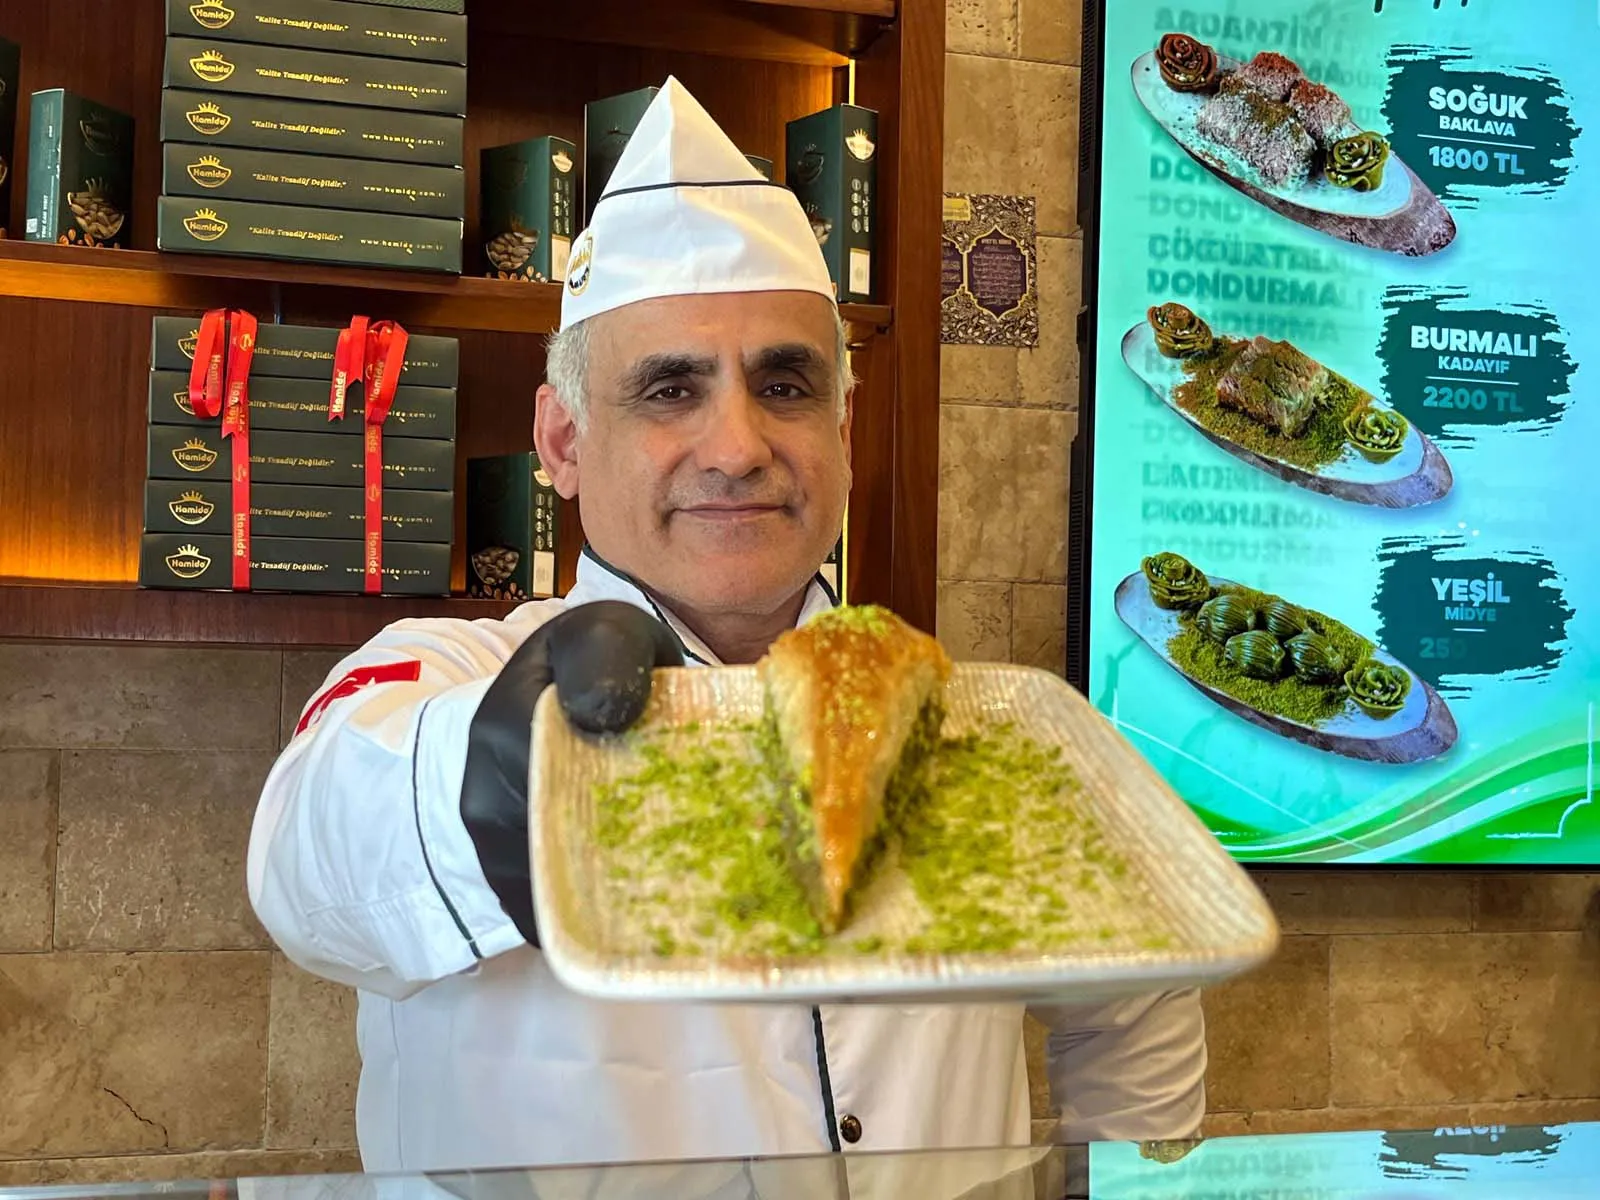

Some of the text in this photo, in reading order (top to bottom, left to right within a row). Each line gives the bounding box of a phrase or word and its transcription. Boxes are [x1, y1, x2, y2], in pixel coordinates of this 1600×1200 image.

[196, 9, 230, 19] Hamido
[196, 62, 230, 73] Hamido
[1428, 84, 1528, 120] SOĞUK
[192, 115, 226, 125] Hamido
[1439, 115, 1517, 138] BAKLAVA
[1428, 146, 1525, 175] 1800 TL
[193, 168, 227, 178] Hamido
[189, 221, 223, 232] Hamido
[1410, 325, 1537, 358] BURMALI
[1438, 355, 1511, 374] KADAYIF
[332, 370, 347, 413] Hamido
[1423, 386, 1523, 412] 2200 TL
[178, 452, 212, 462] Hamido
[175, 505, 209, 514] Hamido
[235, 512, 246, 557] Hamido
[369, 532, 379, 574] Hamido
[171, 559, 205, 568] Hamido
[1431, 573, 1510, 604] YEŞİL
[1444, 602, 1496, 622] MİDYE
